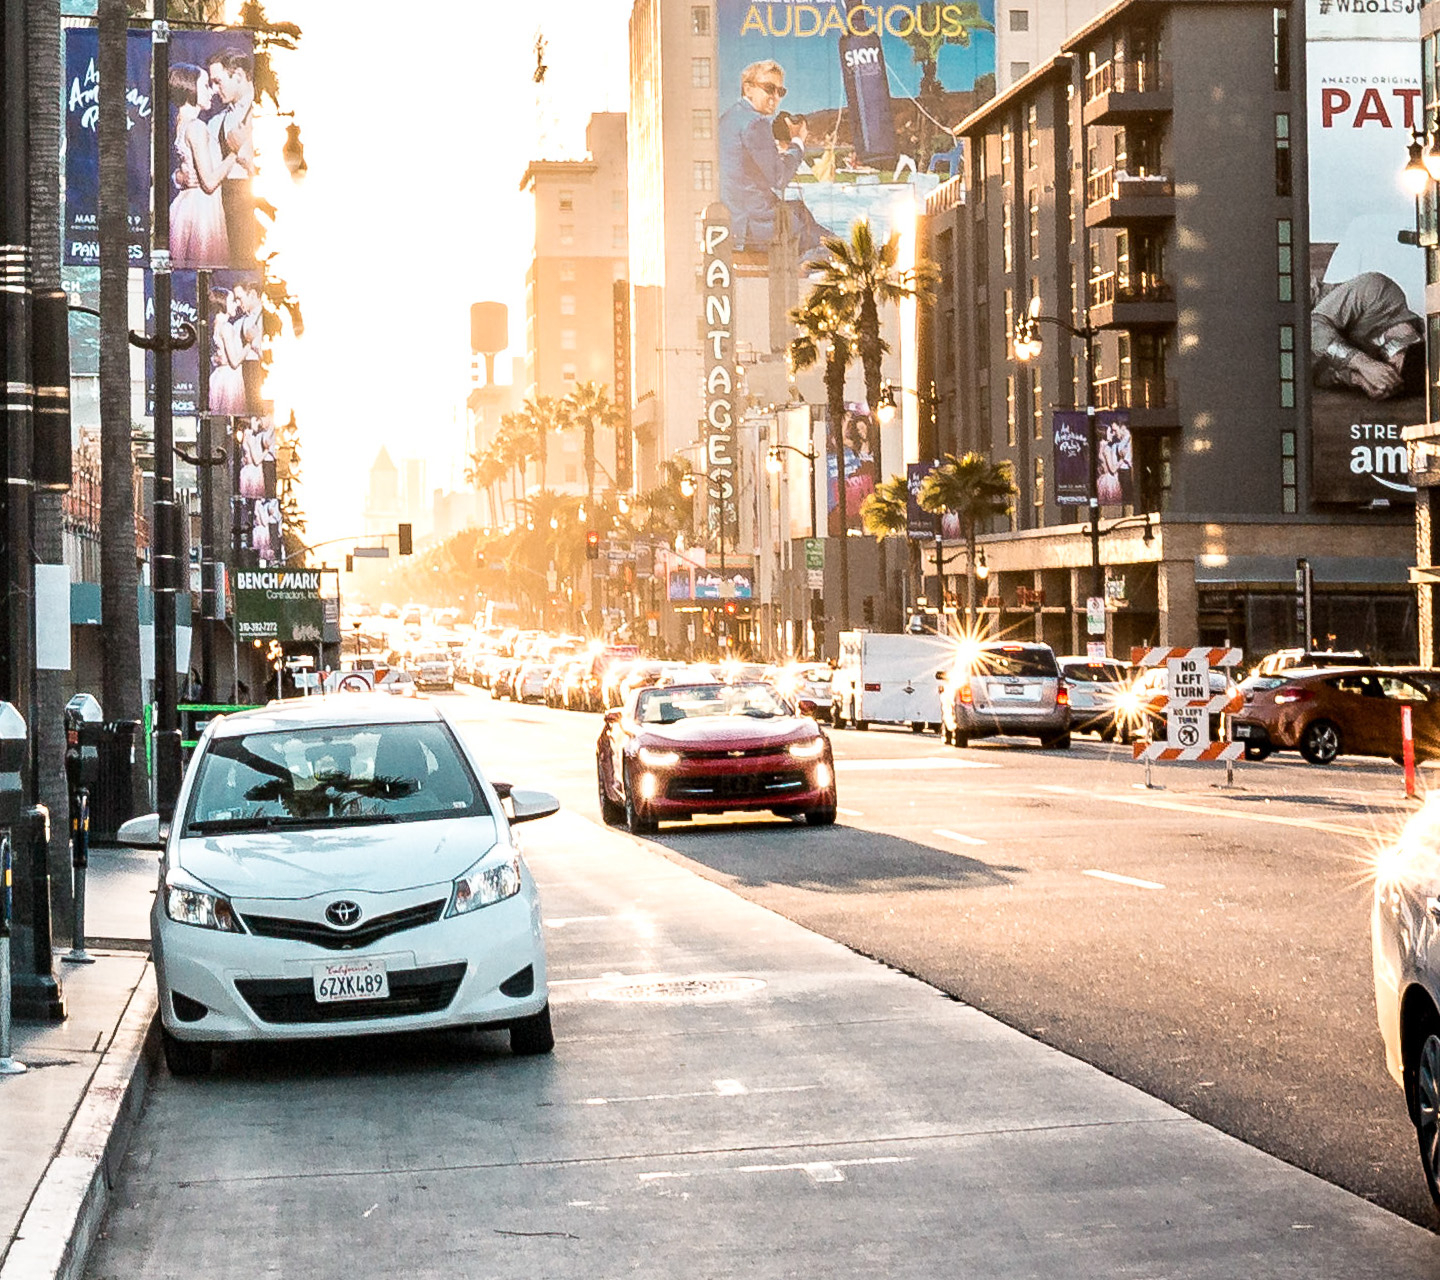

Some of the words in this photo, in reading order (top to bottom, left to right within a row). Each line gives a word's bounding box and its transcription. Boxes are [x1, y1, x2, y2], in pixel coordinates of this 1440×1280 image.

[740, 5, 968, 38] AUDACIOUS.
[844, 47, 880, 67] SKYY
[1321, 76, 1367, 85] AMAZON
[69, 77, 151, 117] Aman
[75, 215, 96, 224] MAR
[71, 242, 144, 258] PANES
[703, 225, 734, 501] PANTAGES
[149, 401, 196, 411] PAGES
[1181, 661, 1197, 672] NO
[1175, 674, 1203, 685] LEFT
[1174, 687, 1204, 698] TURN
[1173, 708, 1184, 717] NO
[1185, 708, 1203, 717] LEFT
[1178, 717, 1199, 725] TURN
[328, 965, 369, 976] California
[319, 973, 383, 997] 6ZXK489
